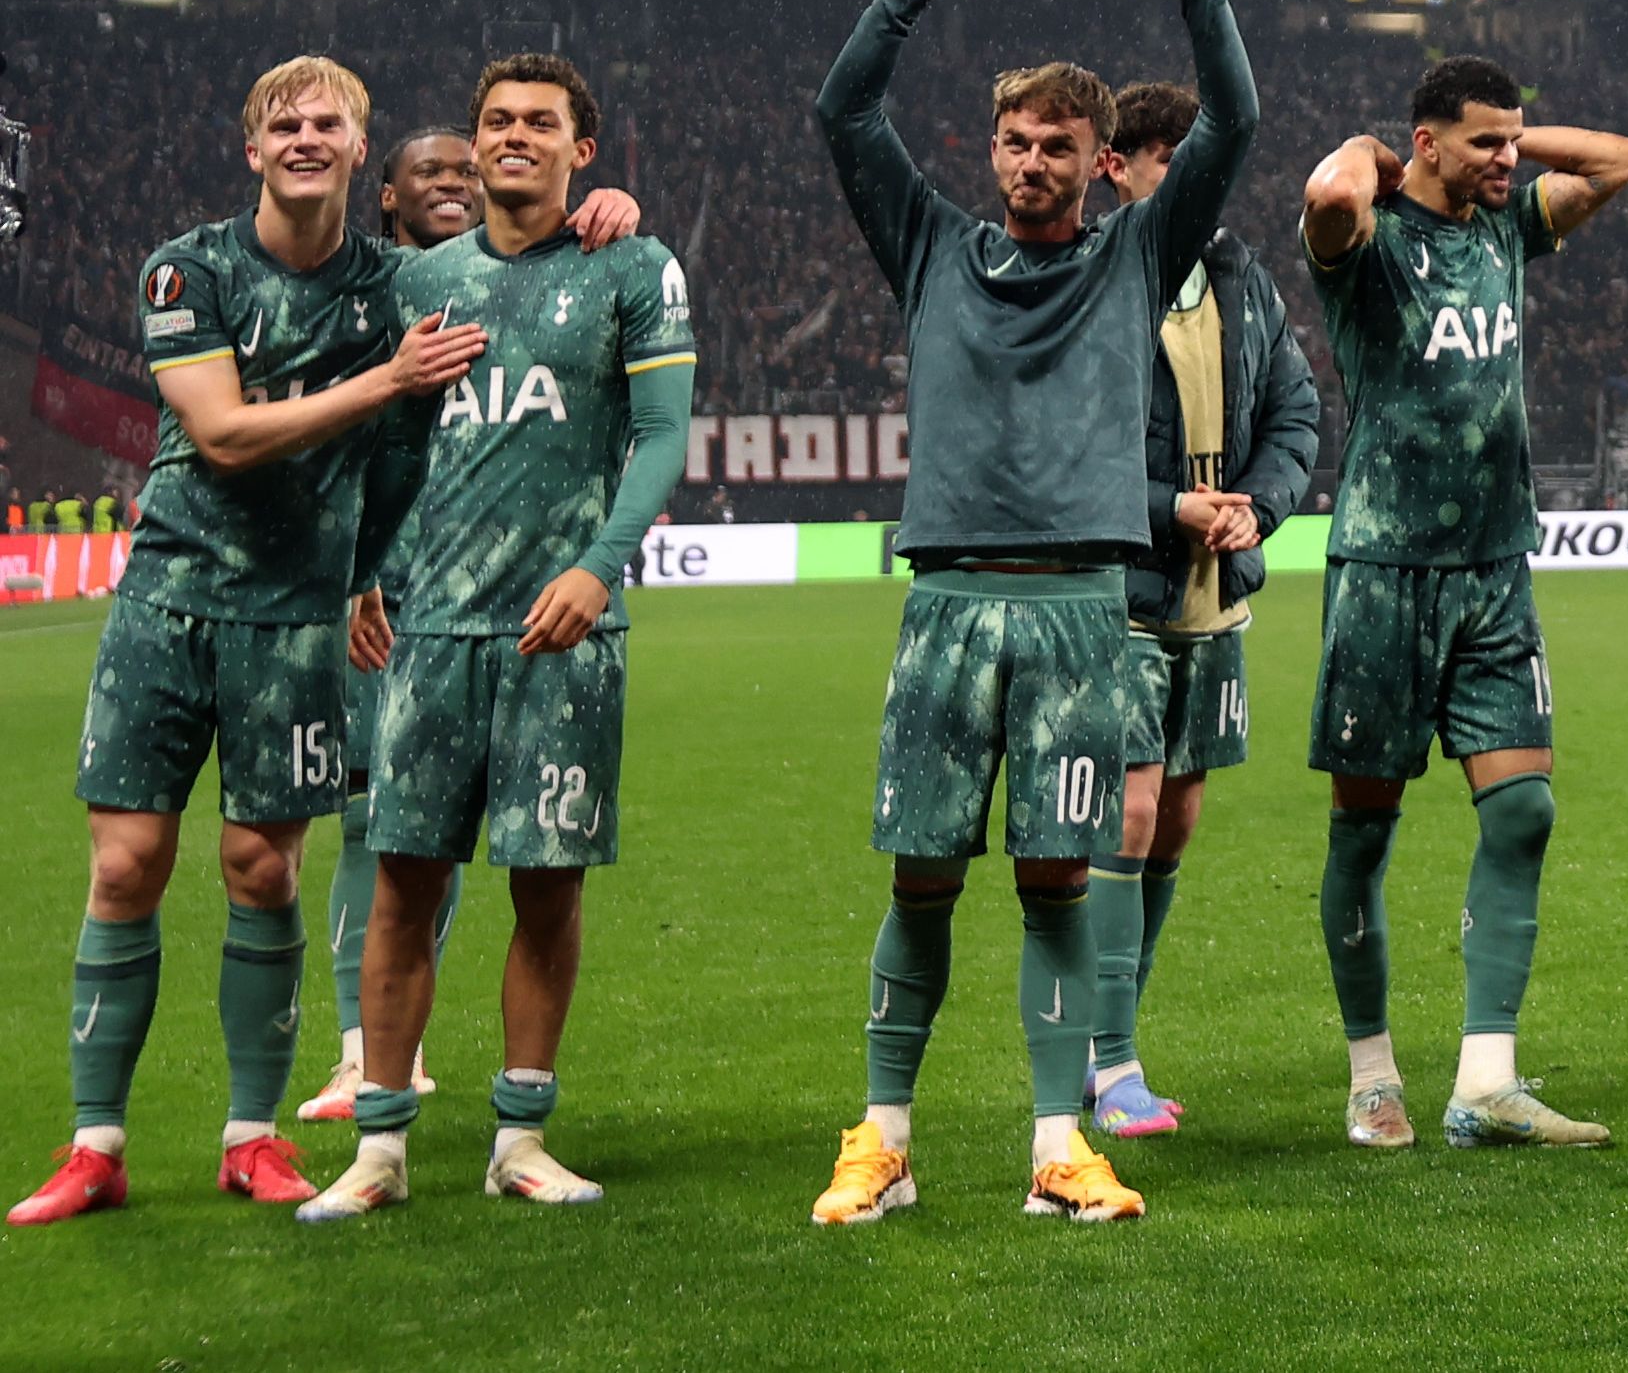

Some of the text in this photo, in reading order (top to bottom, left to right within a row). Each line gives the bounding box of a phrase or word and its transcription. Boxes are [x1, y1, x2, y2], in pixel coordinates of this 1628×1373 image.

[440, 364, 567, 427] AIA
[1218, 679, 1243, 737] 14
[293, 721, 327, 787] 15
[538, 763, 587, 830] 22
[1057, 756, 1095, 824] 10
